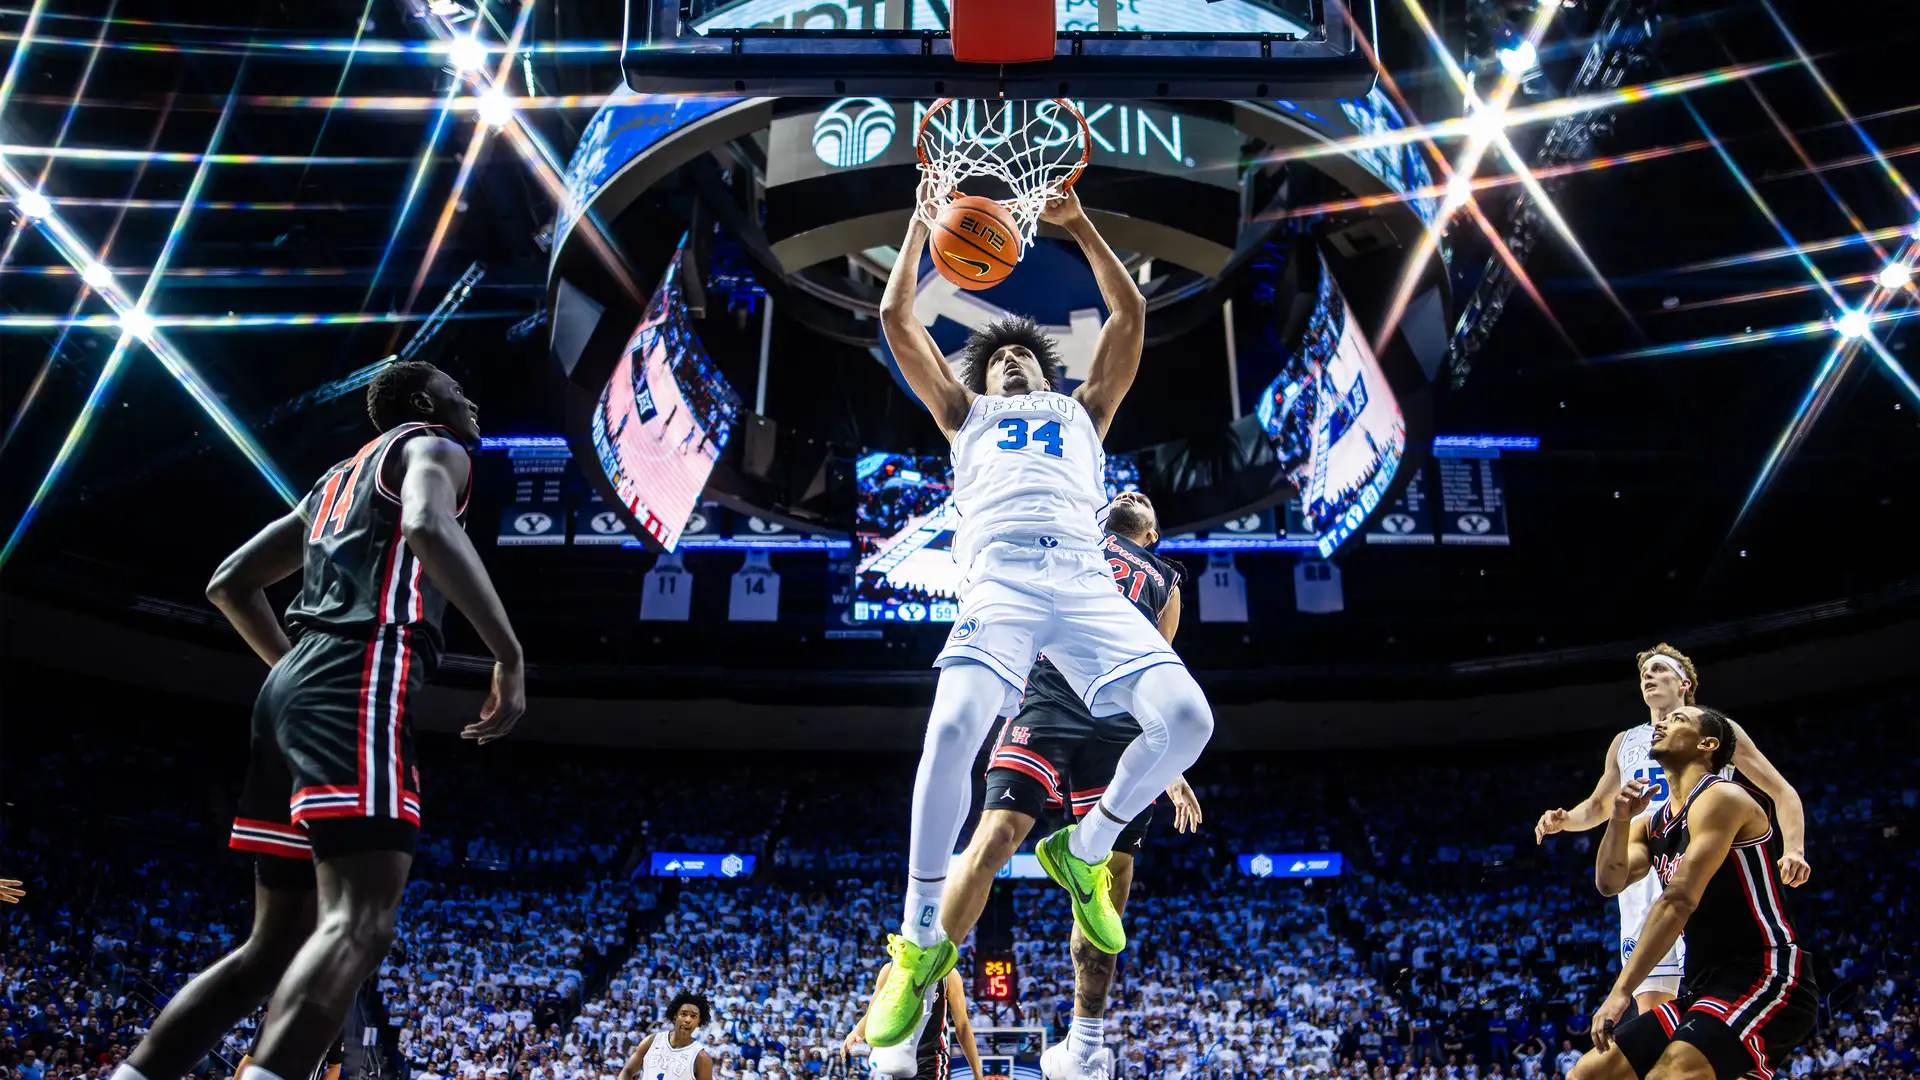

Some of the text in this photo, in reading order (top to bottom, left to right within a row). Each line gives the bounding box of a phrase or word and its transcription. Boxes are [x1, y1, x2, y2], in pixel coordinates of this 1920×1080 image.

[912, 98, 1183, 163] NU SKIN
[960, 215, 1006, 253] ELITE
[982, 394, 1076, 422] BYU
[996, 417, 1064, 458] 34
[308, 457, 365, 545] 14
[658, 575, 676, 596] 11
[744, 576, 766, 596] 14
[1107, 557, 1148, 603] 21
[1214, 571, 1230, 588] 11
[935, 606, 952, 620] 59
[989, 974, 1008, 997] 15
[647, 1054, 688, 1079] BYU
